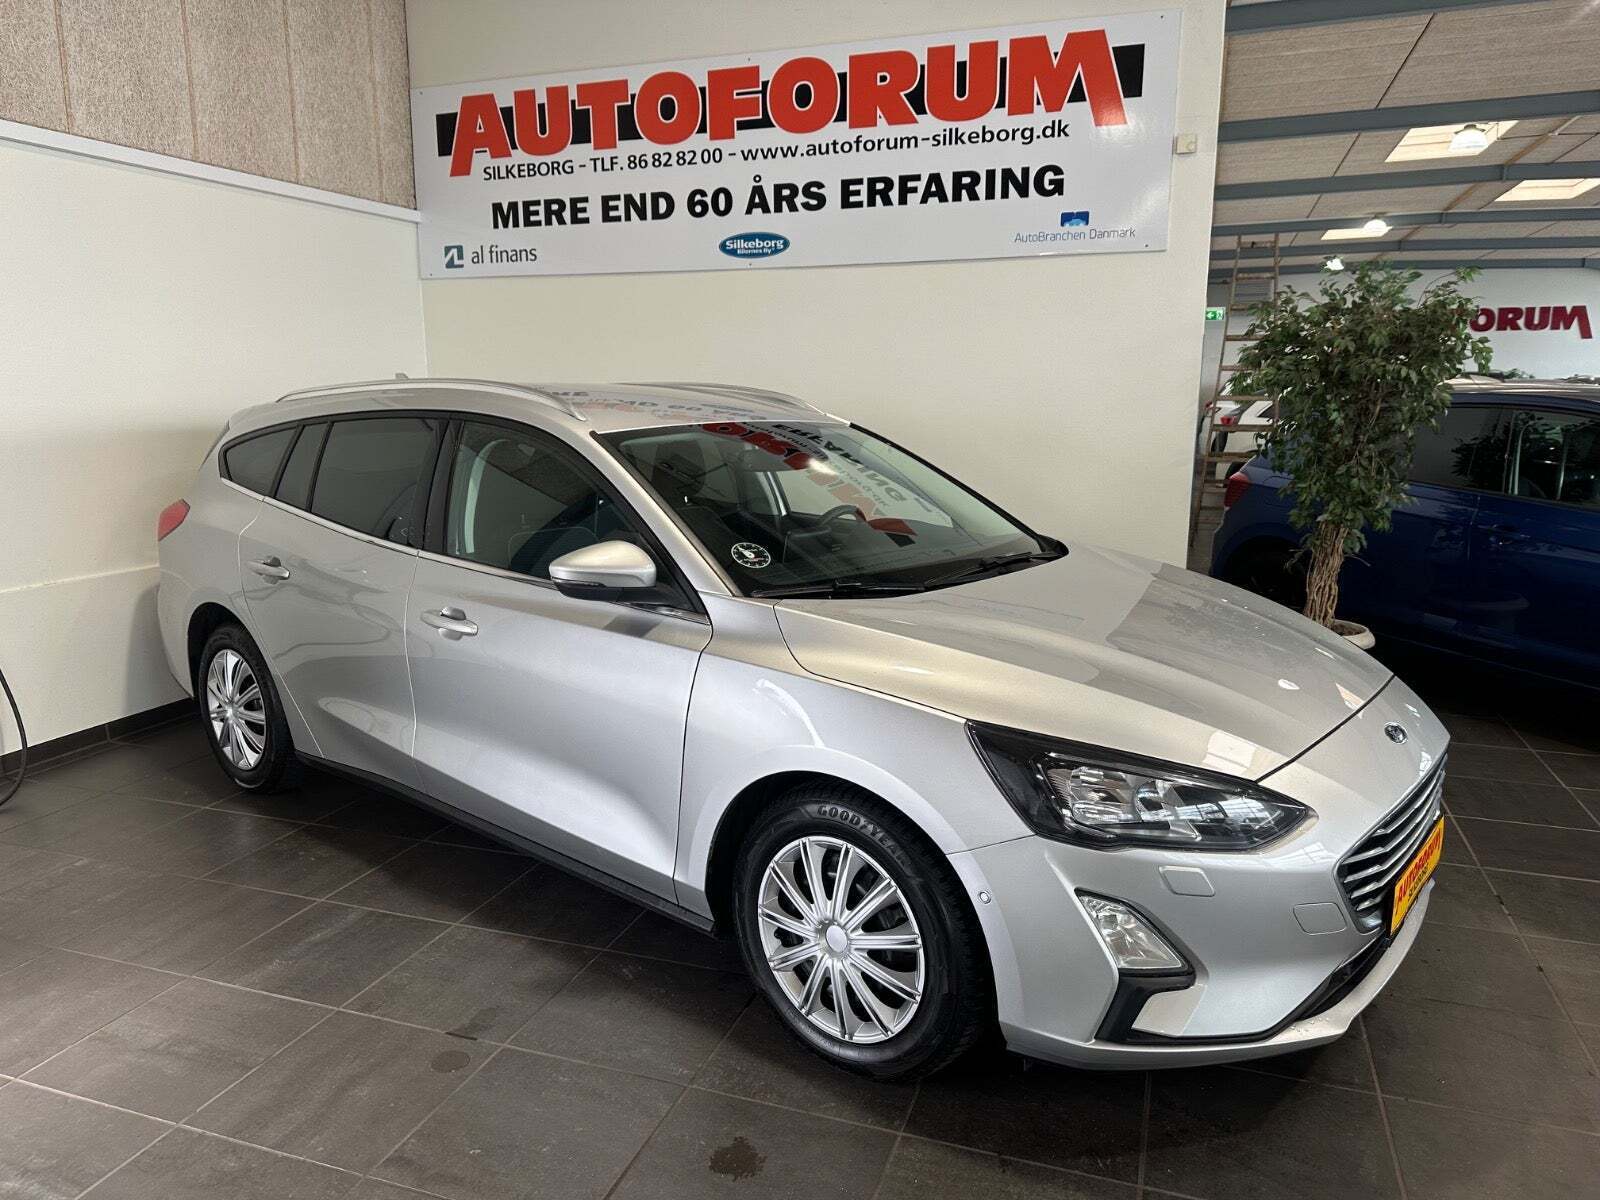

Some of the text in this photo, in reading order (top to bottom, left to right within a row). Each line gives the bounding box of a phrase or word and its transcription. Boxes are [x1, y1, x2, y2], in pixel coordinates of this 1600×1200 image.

[449, 29, 1128, 177] AUTOFORUM
[483, 159, 575, 181] SILKEBORG
[589, 155, 624, 173] TLF.
[627, 154, 648, 170] 86
[651, 152, 673, 168] 82
[676, 150, 697, 166] 82
[701, 147, 723, 164] 00
[740, 119, 1070, 161] www.autoforum-silkeborg.dk
[491, 164, 1065, 230] MERE END 60 ÅRS ERFARING
[471, 244, 538, 265] al finans
[725, 238, 784, 250] Silkeborg
[1014, 227, 1137, 244] AutoBranchen Danmark
